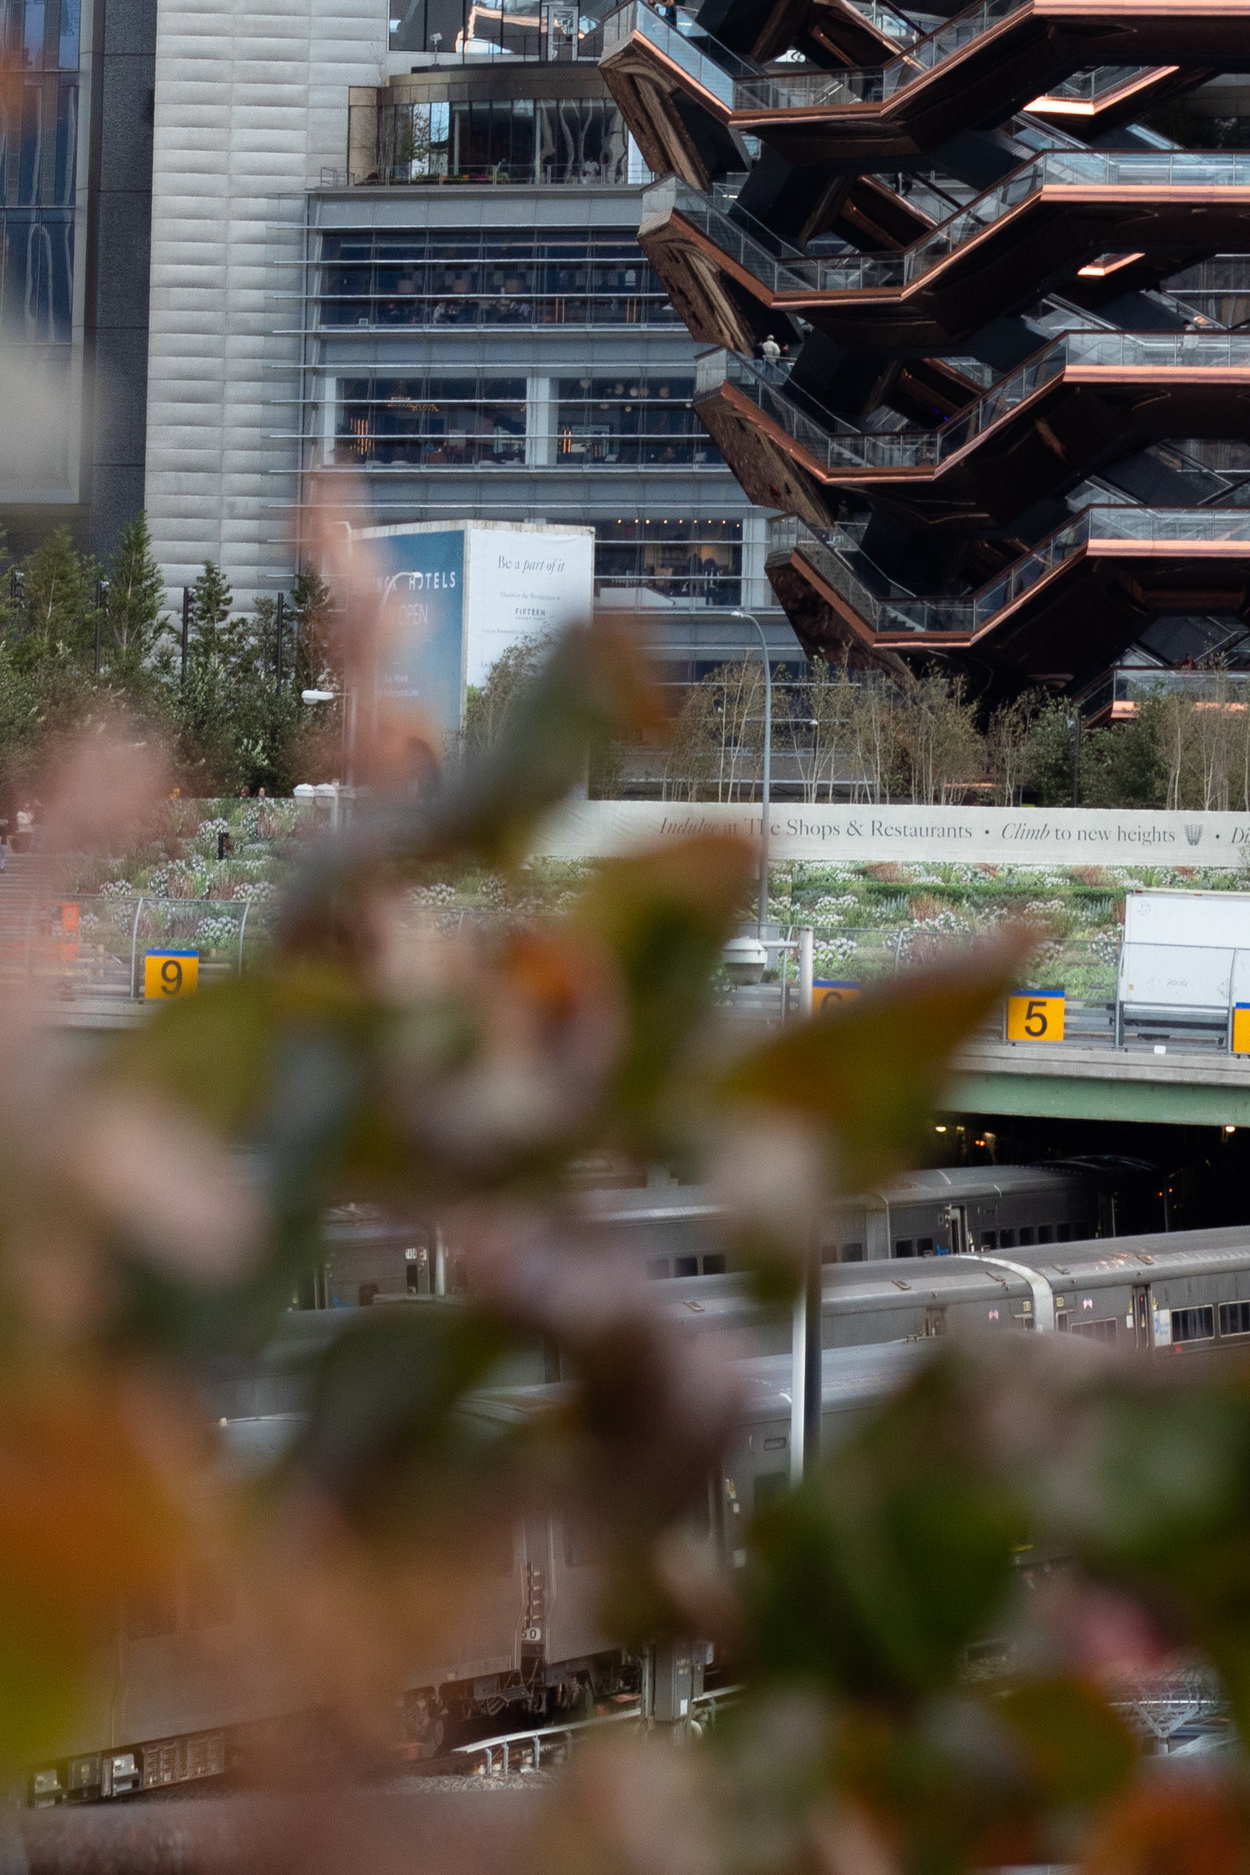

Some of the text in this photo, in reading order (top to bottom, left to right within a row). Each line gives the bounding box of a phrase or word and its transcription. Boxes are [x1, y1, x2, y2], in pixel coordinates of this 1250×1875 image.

[498, 555, 566, 574] Be a part of it
[514, 608, 546, 617] FIFTEEN
[786, 818, 840, 840] Shops
[846, 819, 863, 837] &
[871, 820, 973, 839] Restaurants
[1001, 822, 1050, 840] Climb
[1055, 828, 1072, 841] to
[1077, 829, 1111, 842] new
[1117, 825, 1176, 845] heights
[161, 959, 183, 995] 9
[1025, 1001, 1047, 1037] 5
